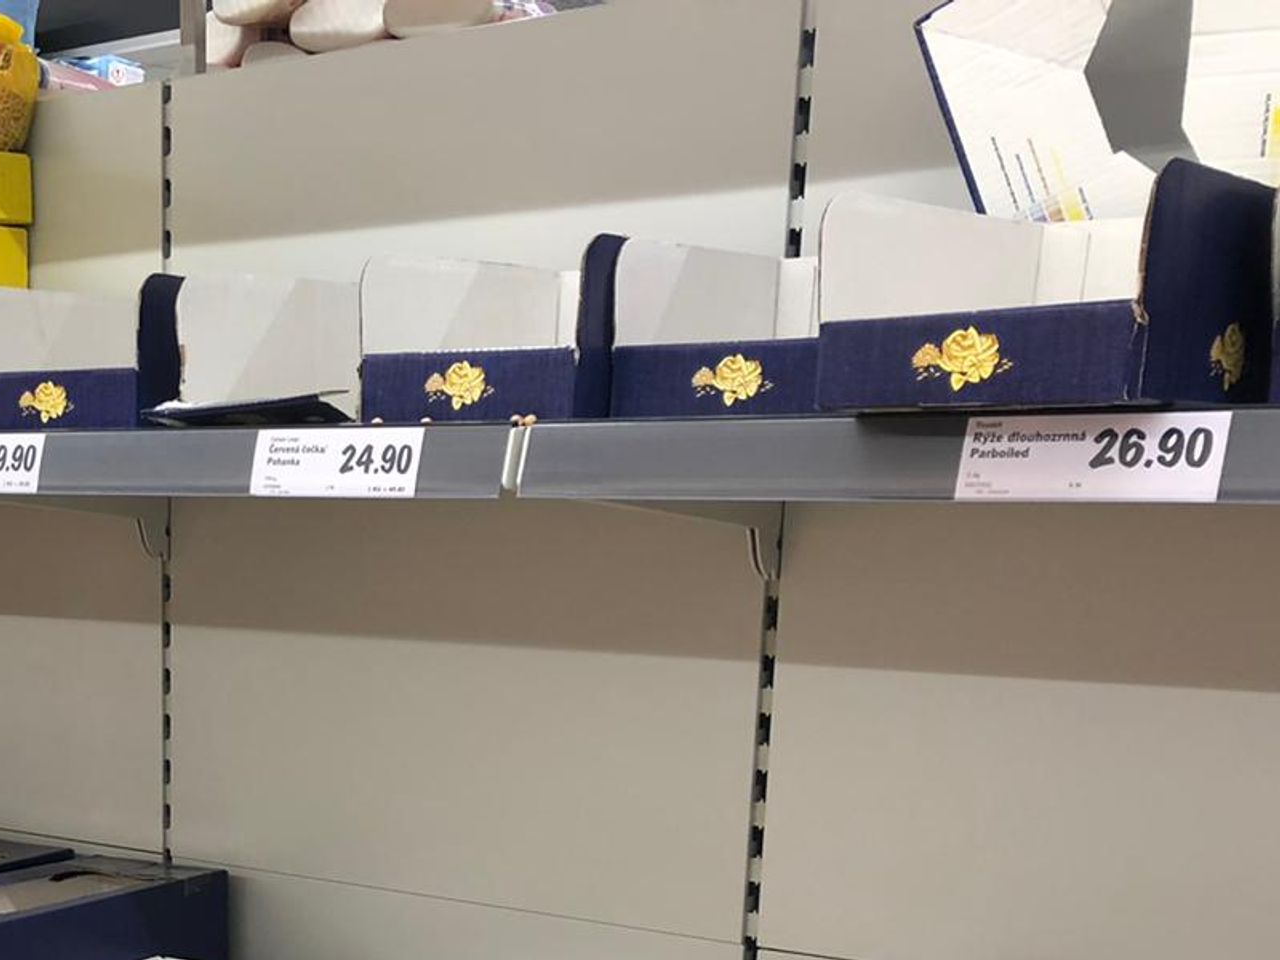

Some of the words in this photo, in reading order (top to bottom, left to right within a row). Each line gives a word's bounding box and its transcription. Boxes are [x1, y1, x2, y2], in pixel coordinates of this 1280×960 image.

[972, 431, 1003, 444] Rýže
[1007, 430, 1087, 443] dlouhozrnná
[1089, 427, 1214, 469] 26.90
[339, 443, 413, 475] 24.90
[970, 447, 1031, 459] Parboiled
